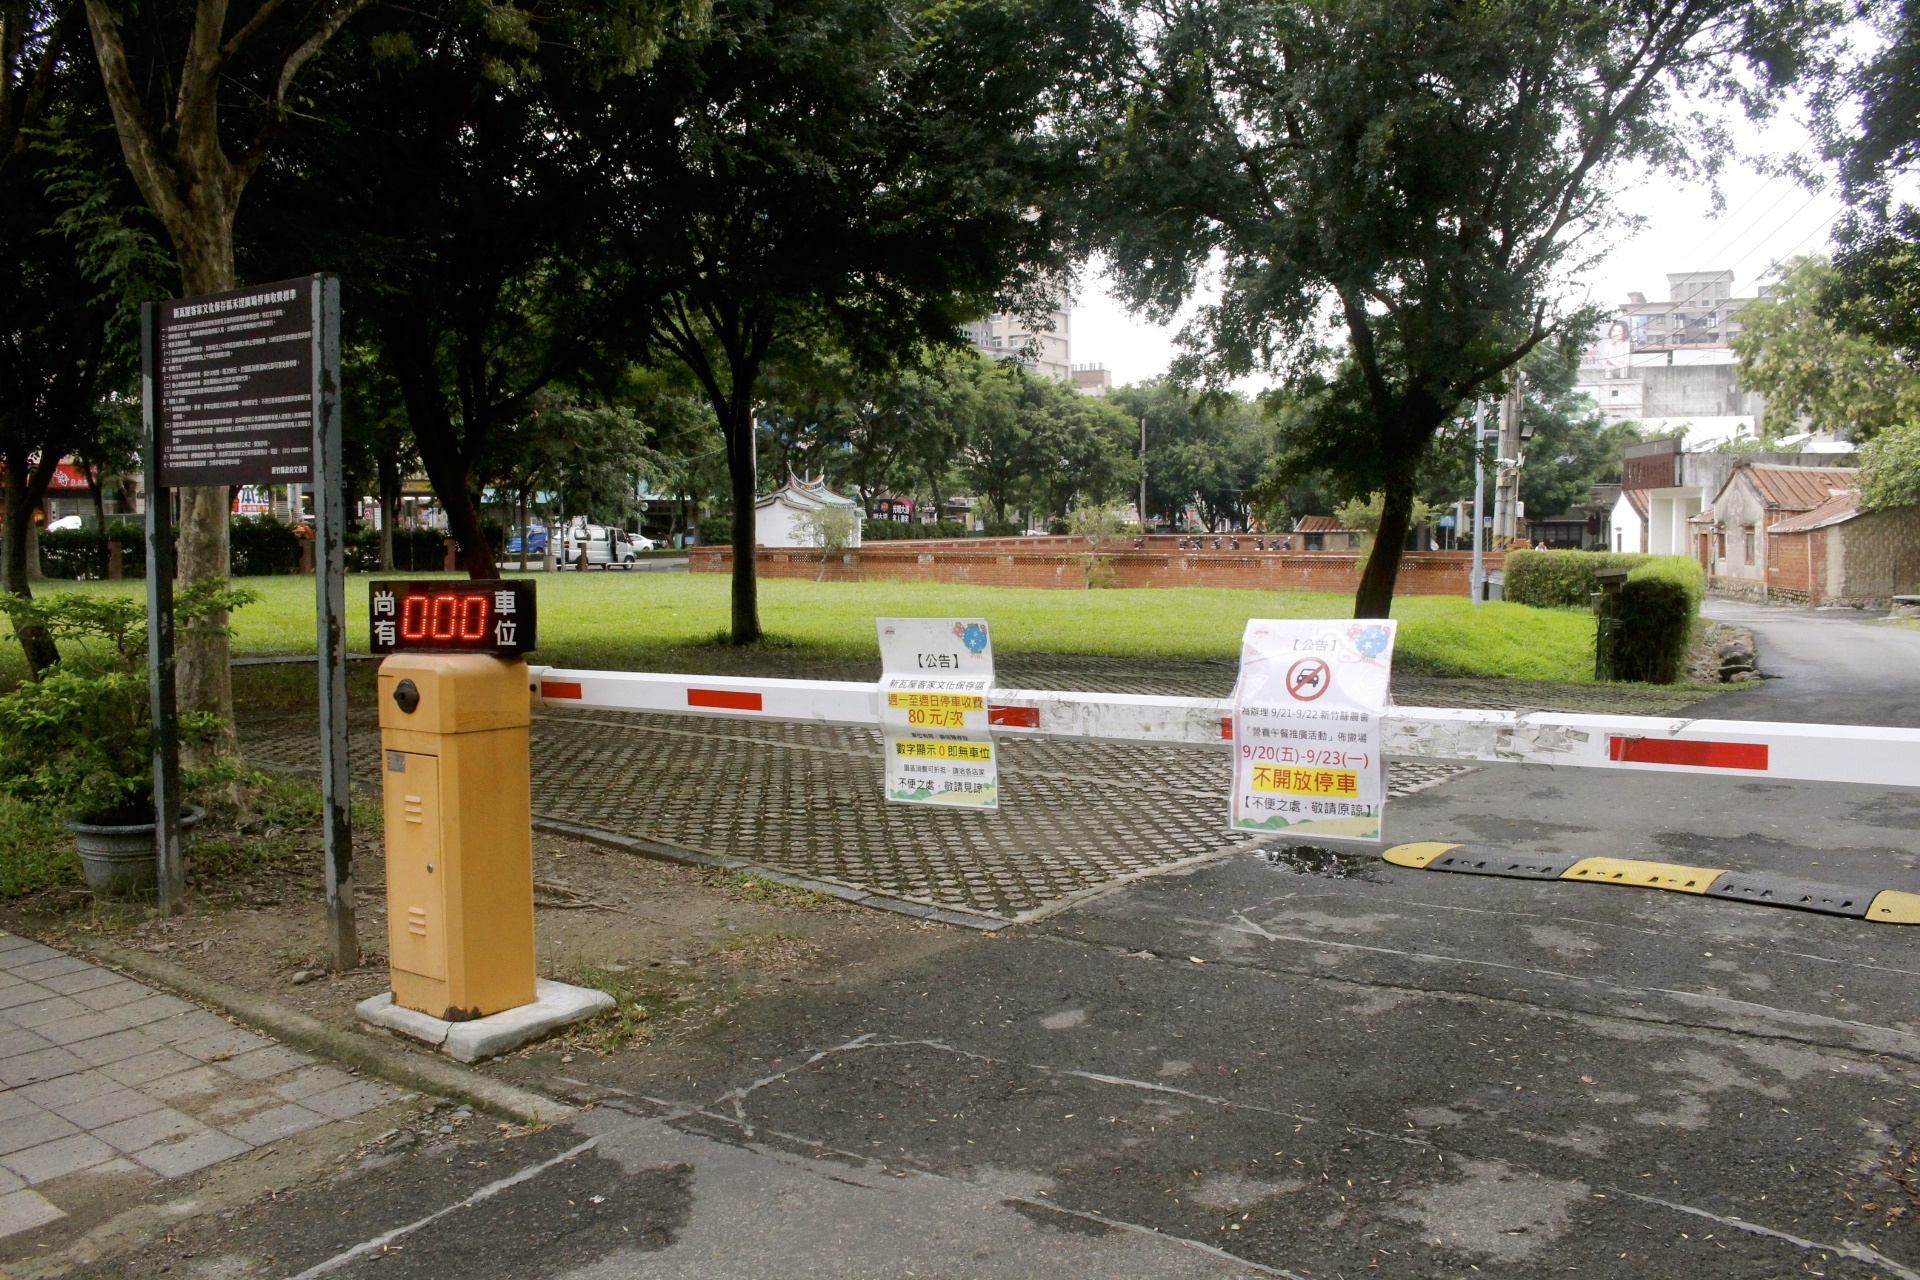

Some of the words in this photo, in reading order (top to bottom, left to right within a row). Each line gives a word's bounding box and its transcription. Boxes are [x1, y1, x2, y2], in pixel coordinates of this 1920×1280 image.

[373, 590, 396, 646] 尚有
[403, 596, 487, 639] 000
[494, 590, 517, 646] 車位
[1291, 638, 1336, 652] 【公告】
[917, 653, 959, 669] 【公告】
[889, 679, 986, 692] 新瓦屋客家文化保存區
[888, 693, 983, 709] 週一至週日停車收費
[908, 709, 925, 723] 80
[929, 708, 964, 727] 元/次
[1242, 706, 1269, 717] 為辦理
[1271, 708, 1317, 720] 9/21-9/22
[1320, 710, 1369, 722] 新竹縣農會
[896, 742, 936, 756] 數字顯示
[938, 745, 946, 757] 0
[948, 745, 990, 759] 即無車位
[1242, 745, 1369, 769] 9/20(五)-9/23(一)
[1253, 767, 1357, 794] 不開放停車
